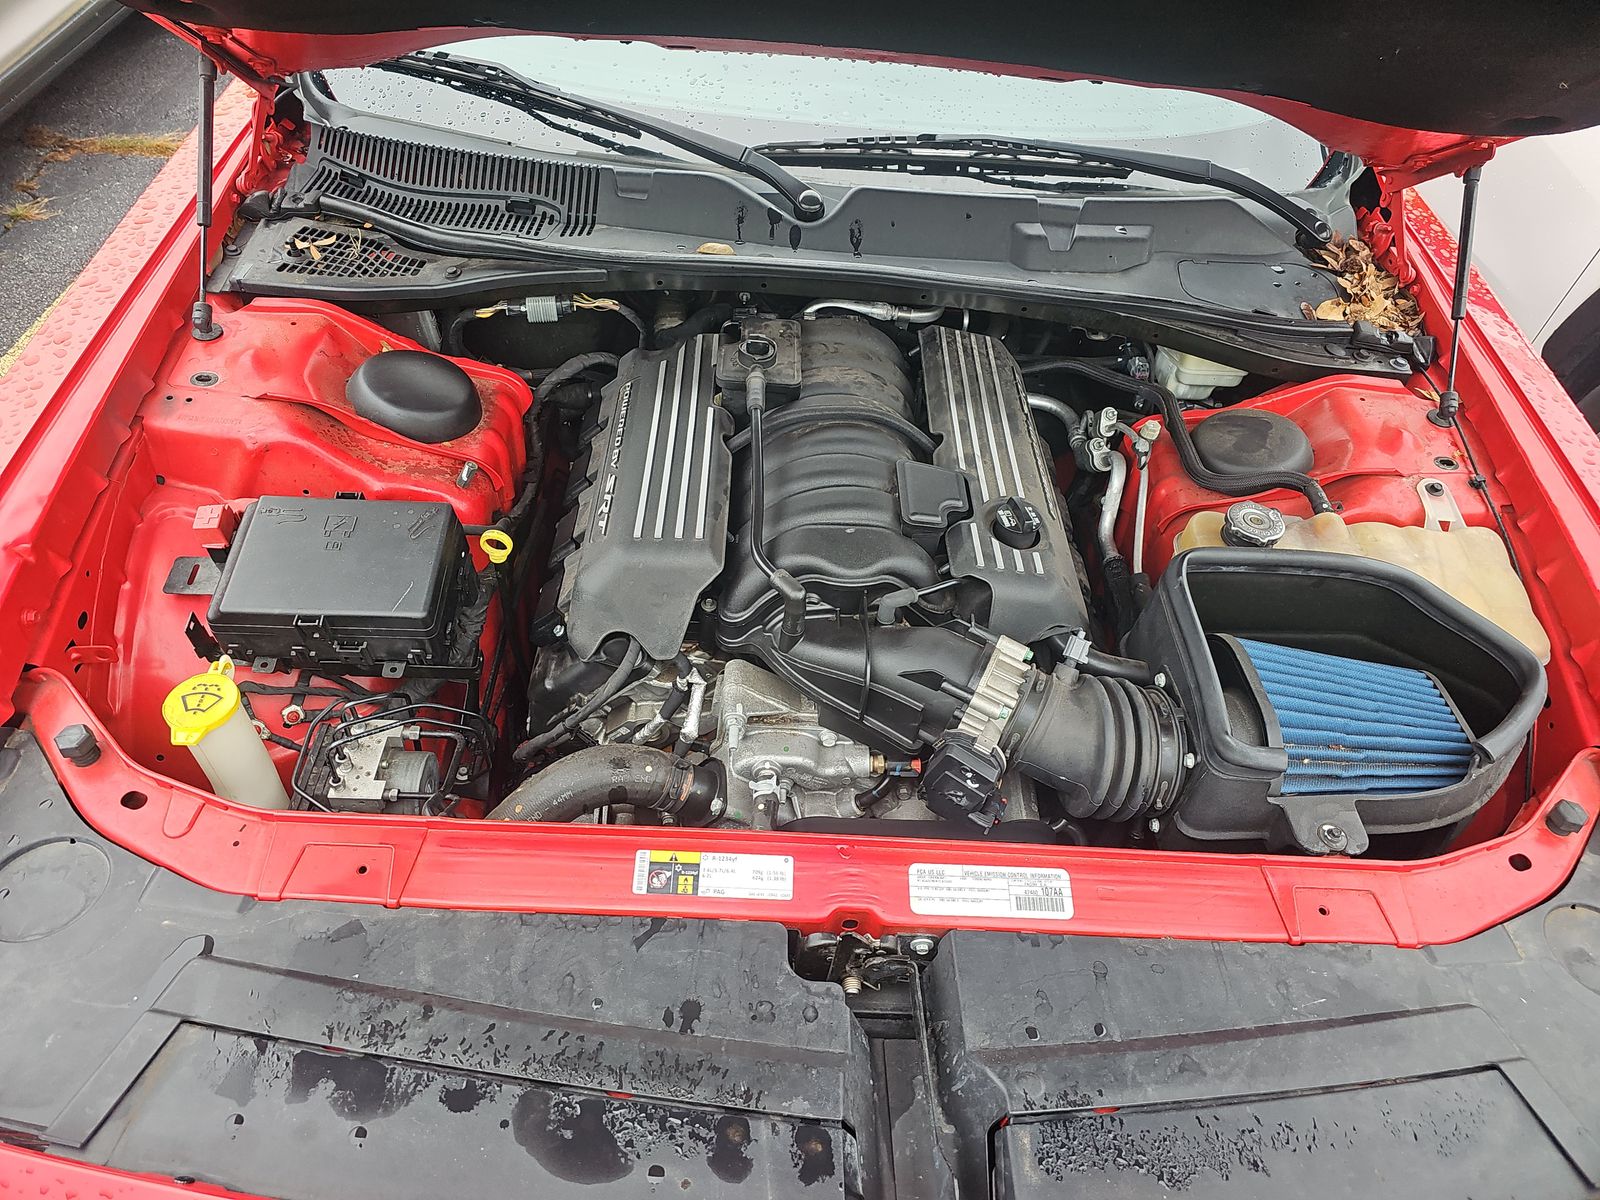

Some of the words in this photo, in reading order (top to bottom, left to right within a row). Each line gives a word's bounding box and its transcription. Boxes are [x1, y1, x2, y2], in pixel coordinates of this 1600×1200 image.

[614, 381, 632, 447] POWERED
[610, 449, 620, 469] BY
[598, 473, 617, 536] SRT
[552, 790, 574, 806] 44MM
[711, 855, 738, 863] R-1234yf
[1041, 886, 1064, 897] 107AA
